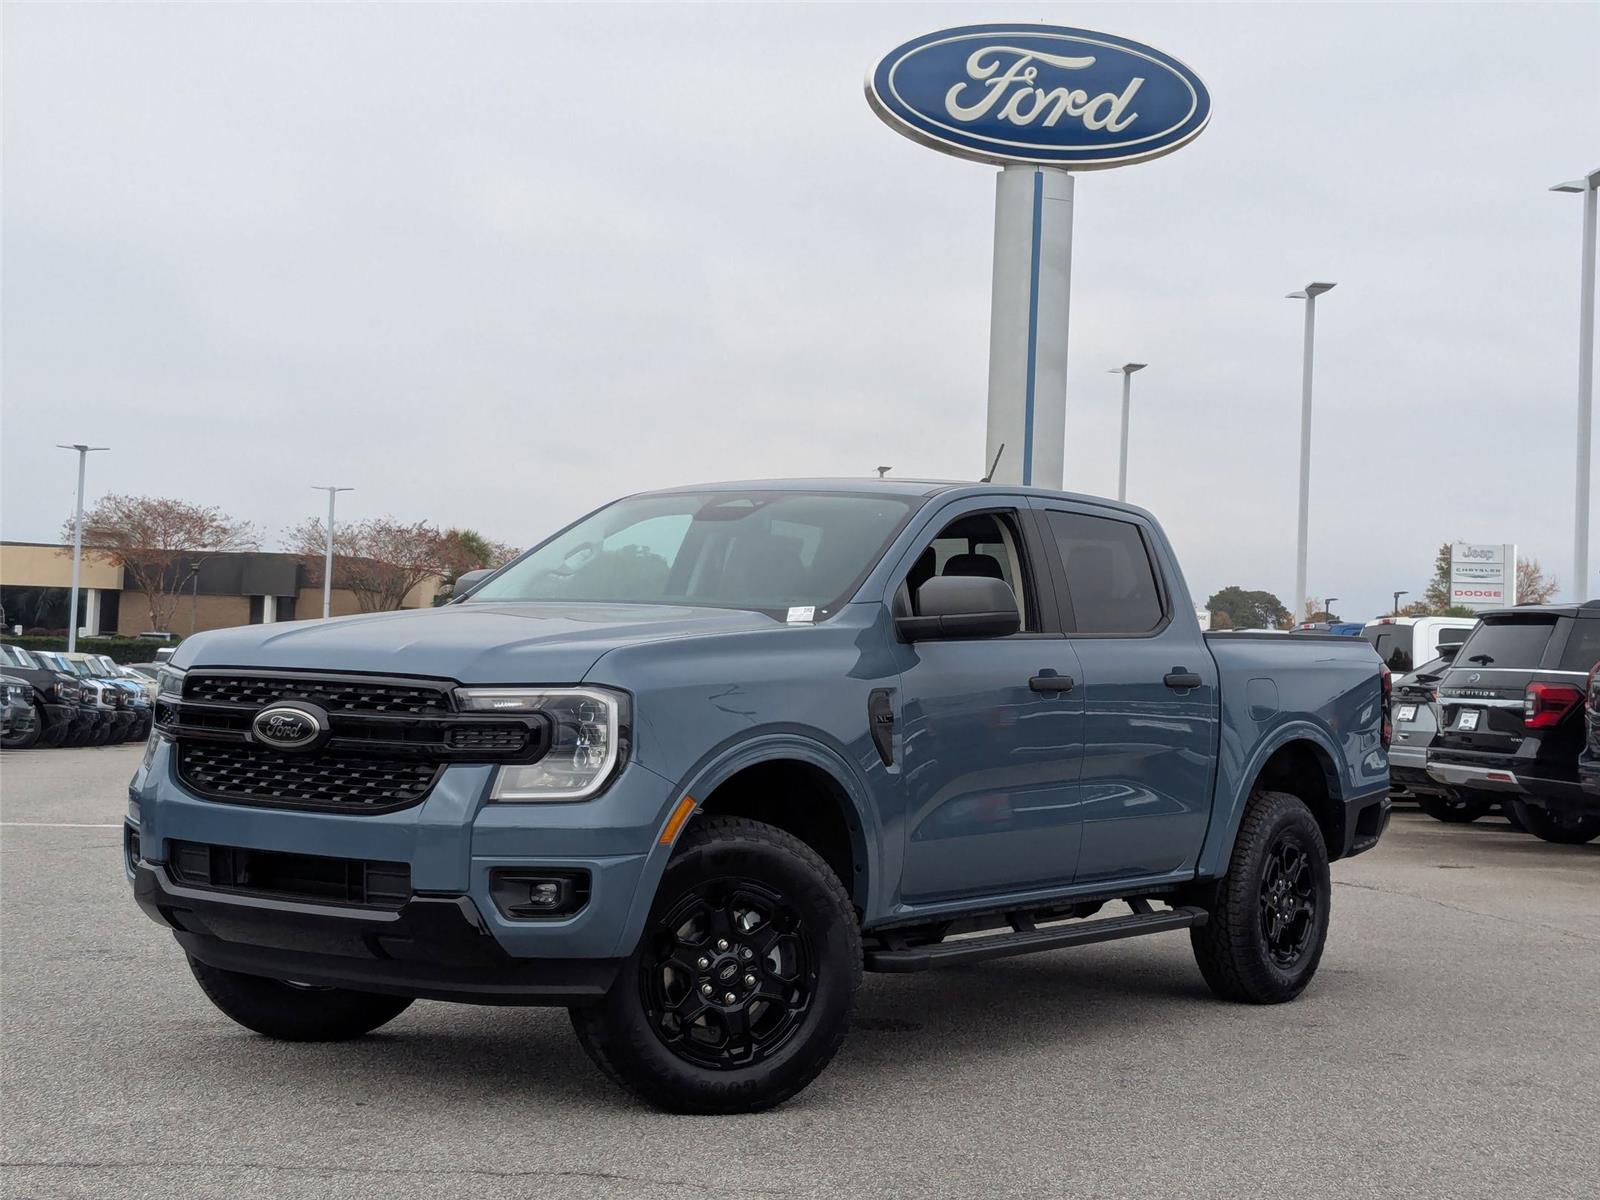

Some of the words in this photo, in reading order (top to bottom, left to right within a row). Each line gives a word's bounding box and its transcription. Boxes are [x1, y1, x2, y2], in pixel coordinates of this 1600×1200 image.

[945, 46, 1145, 133] Ford
[1462, 546, 1494, 561] Jeep
[1454, 590, 1502, 598] DODGE
[266, 715, 302, 738] Ford
